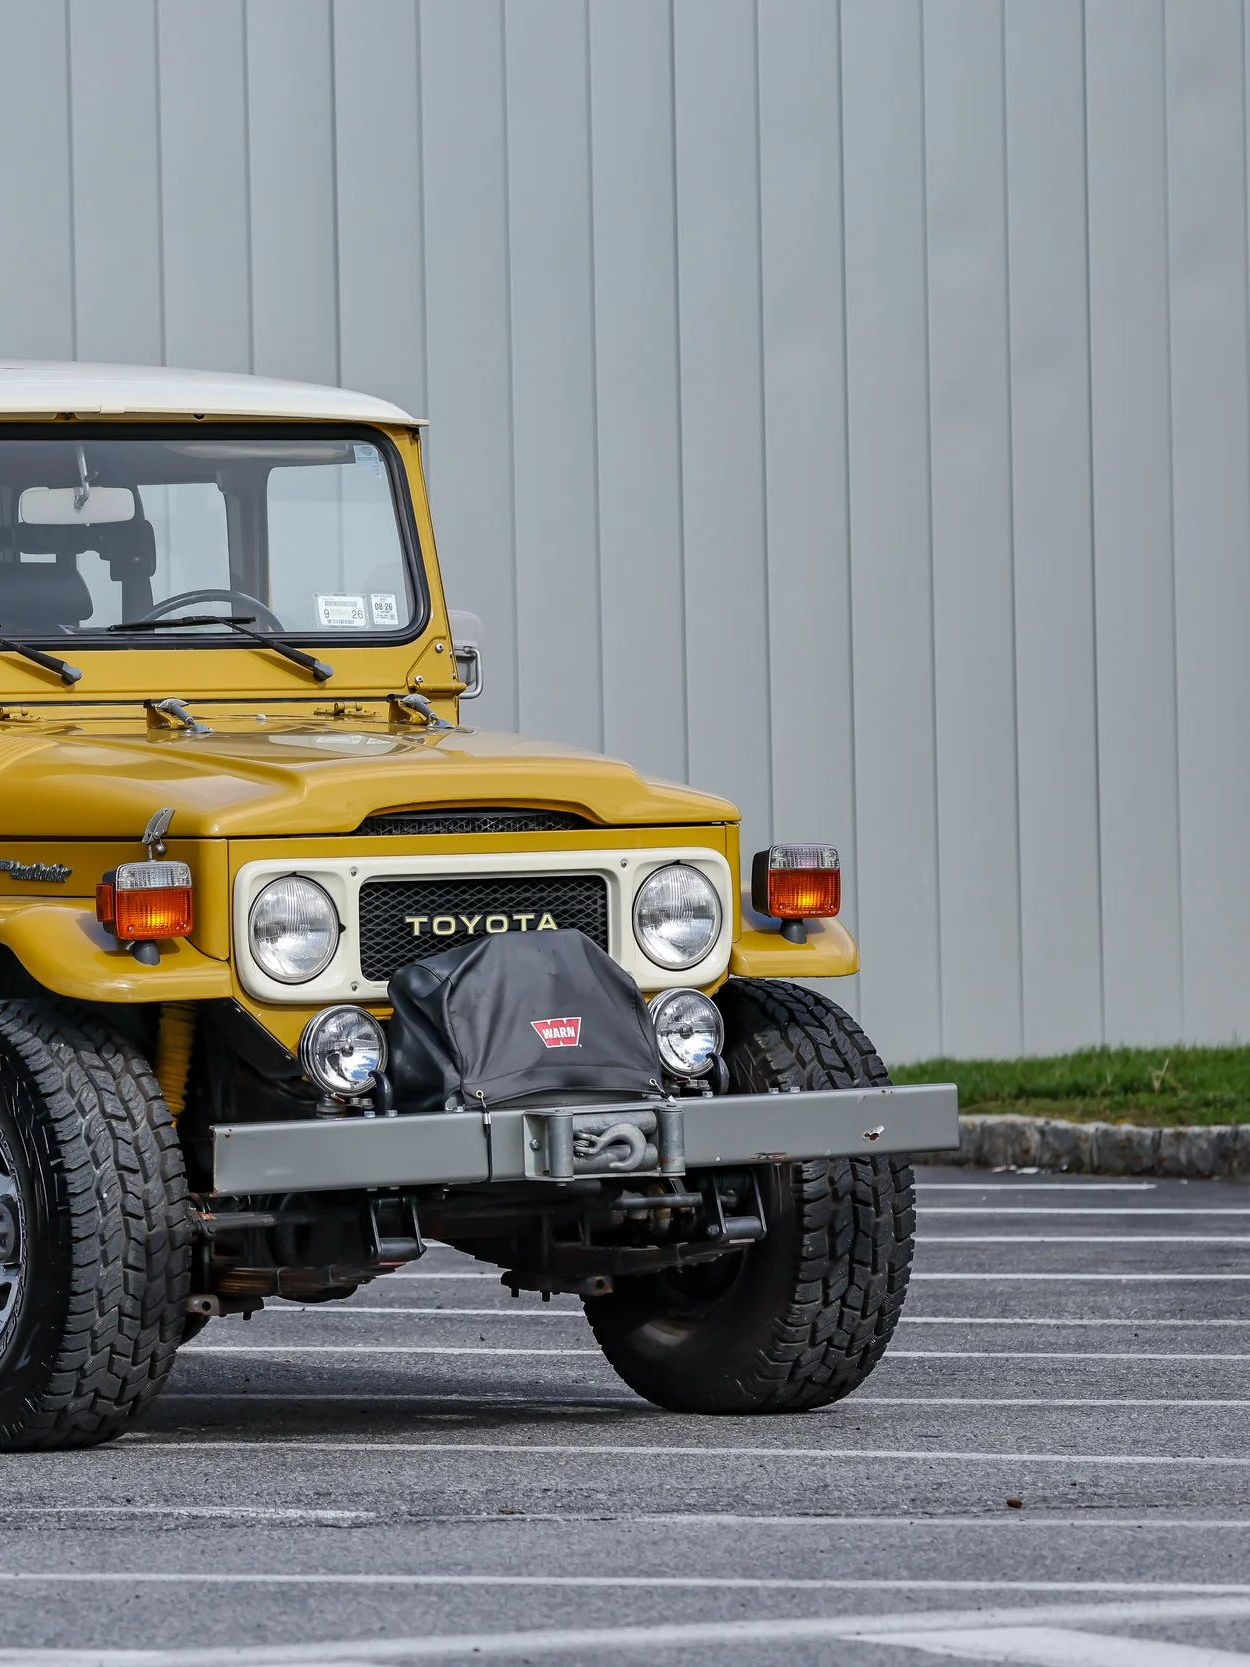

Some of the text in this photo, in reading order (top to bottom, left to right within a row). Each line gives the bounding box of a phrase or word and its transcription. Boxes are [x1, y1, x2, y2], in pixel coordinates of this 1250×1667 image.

[323, 608, 363, 619] 9 26
[405, 912, 558, 936] TOYOTA
[542, 1026, 576, 1040] WARN
